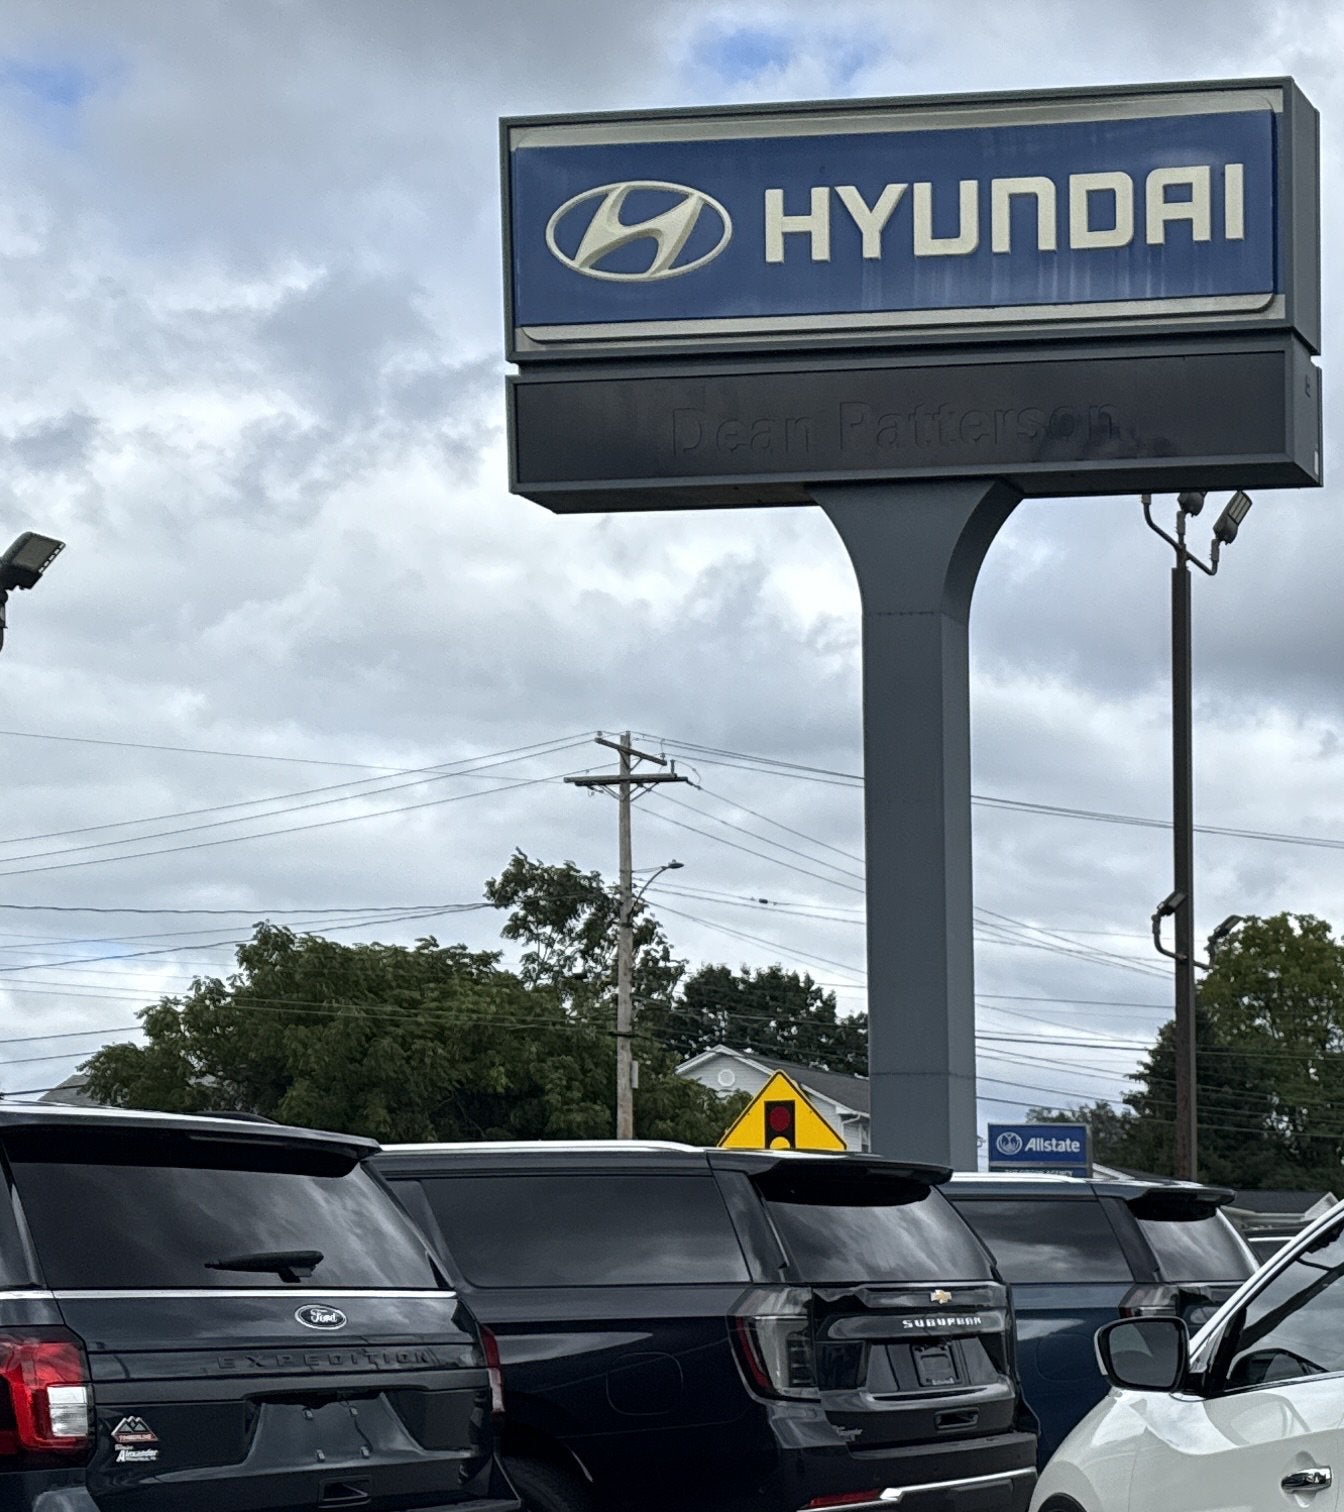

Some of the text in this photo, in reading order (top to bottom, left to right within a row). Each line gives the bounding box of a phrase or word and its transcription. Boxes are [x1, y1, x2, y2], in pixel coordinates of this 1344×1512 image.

[764, 163, 1246, 264] HYUNDAI
[671, 398, 1119, 456] Dean Patterson
[1024, 1137, 1080, 1152] Allstate
[309, 1308, 338, 1324] Ford
[902, 1316, 982, 1329] SUBURBAN
[217, 1351, 430, 1371] EXPEDITION
